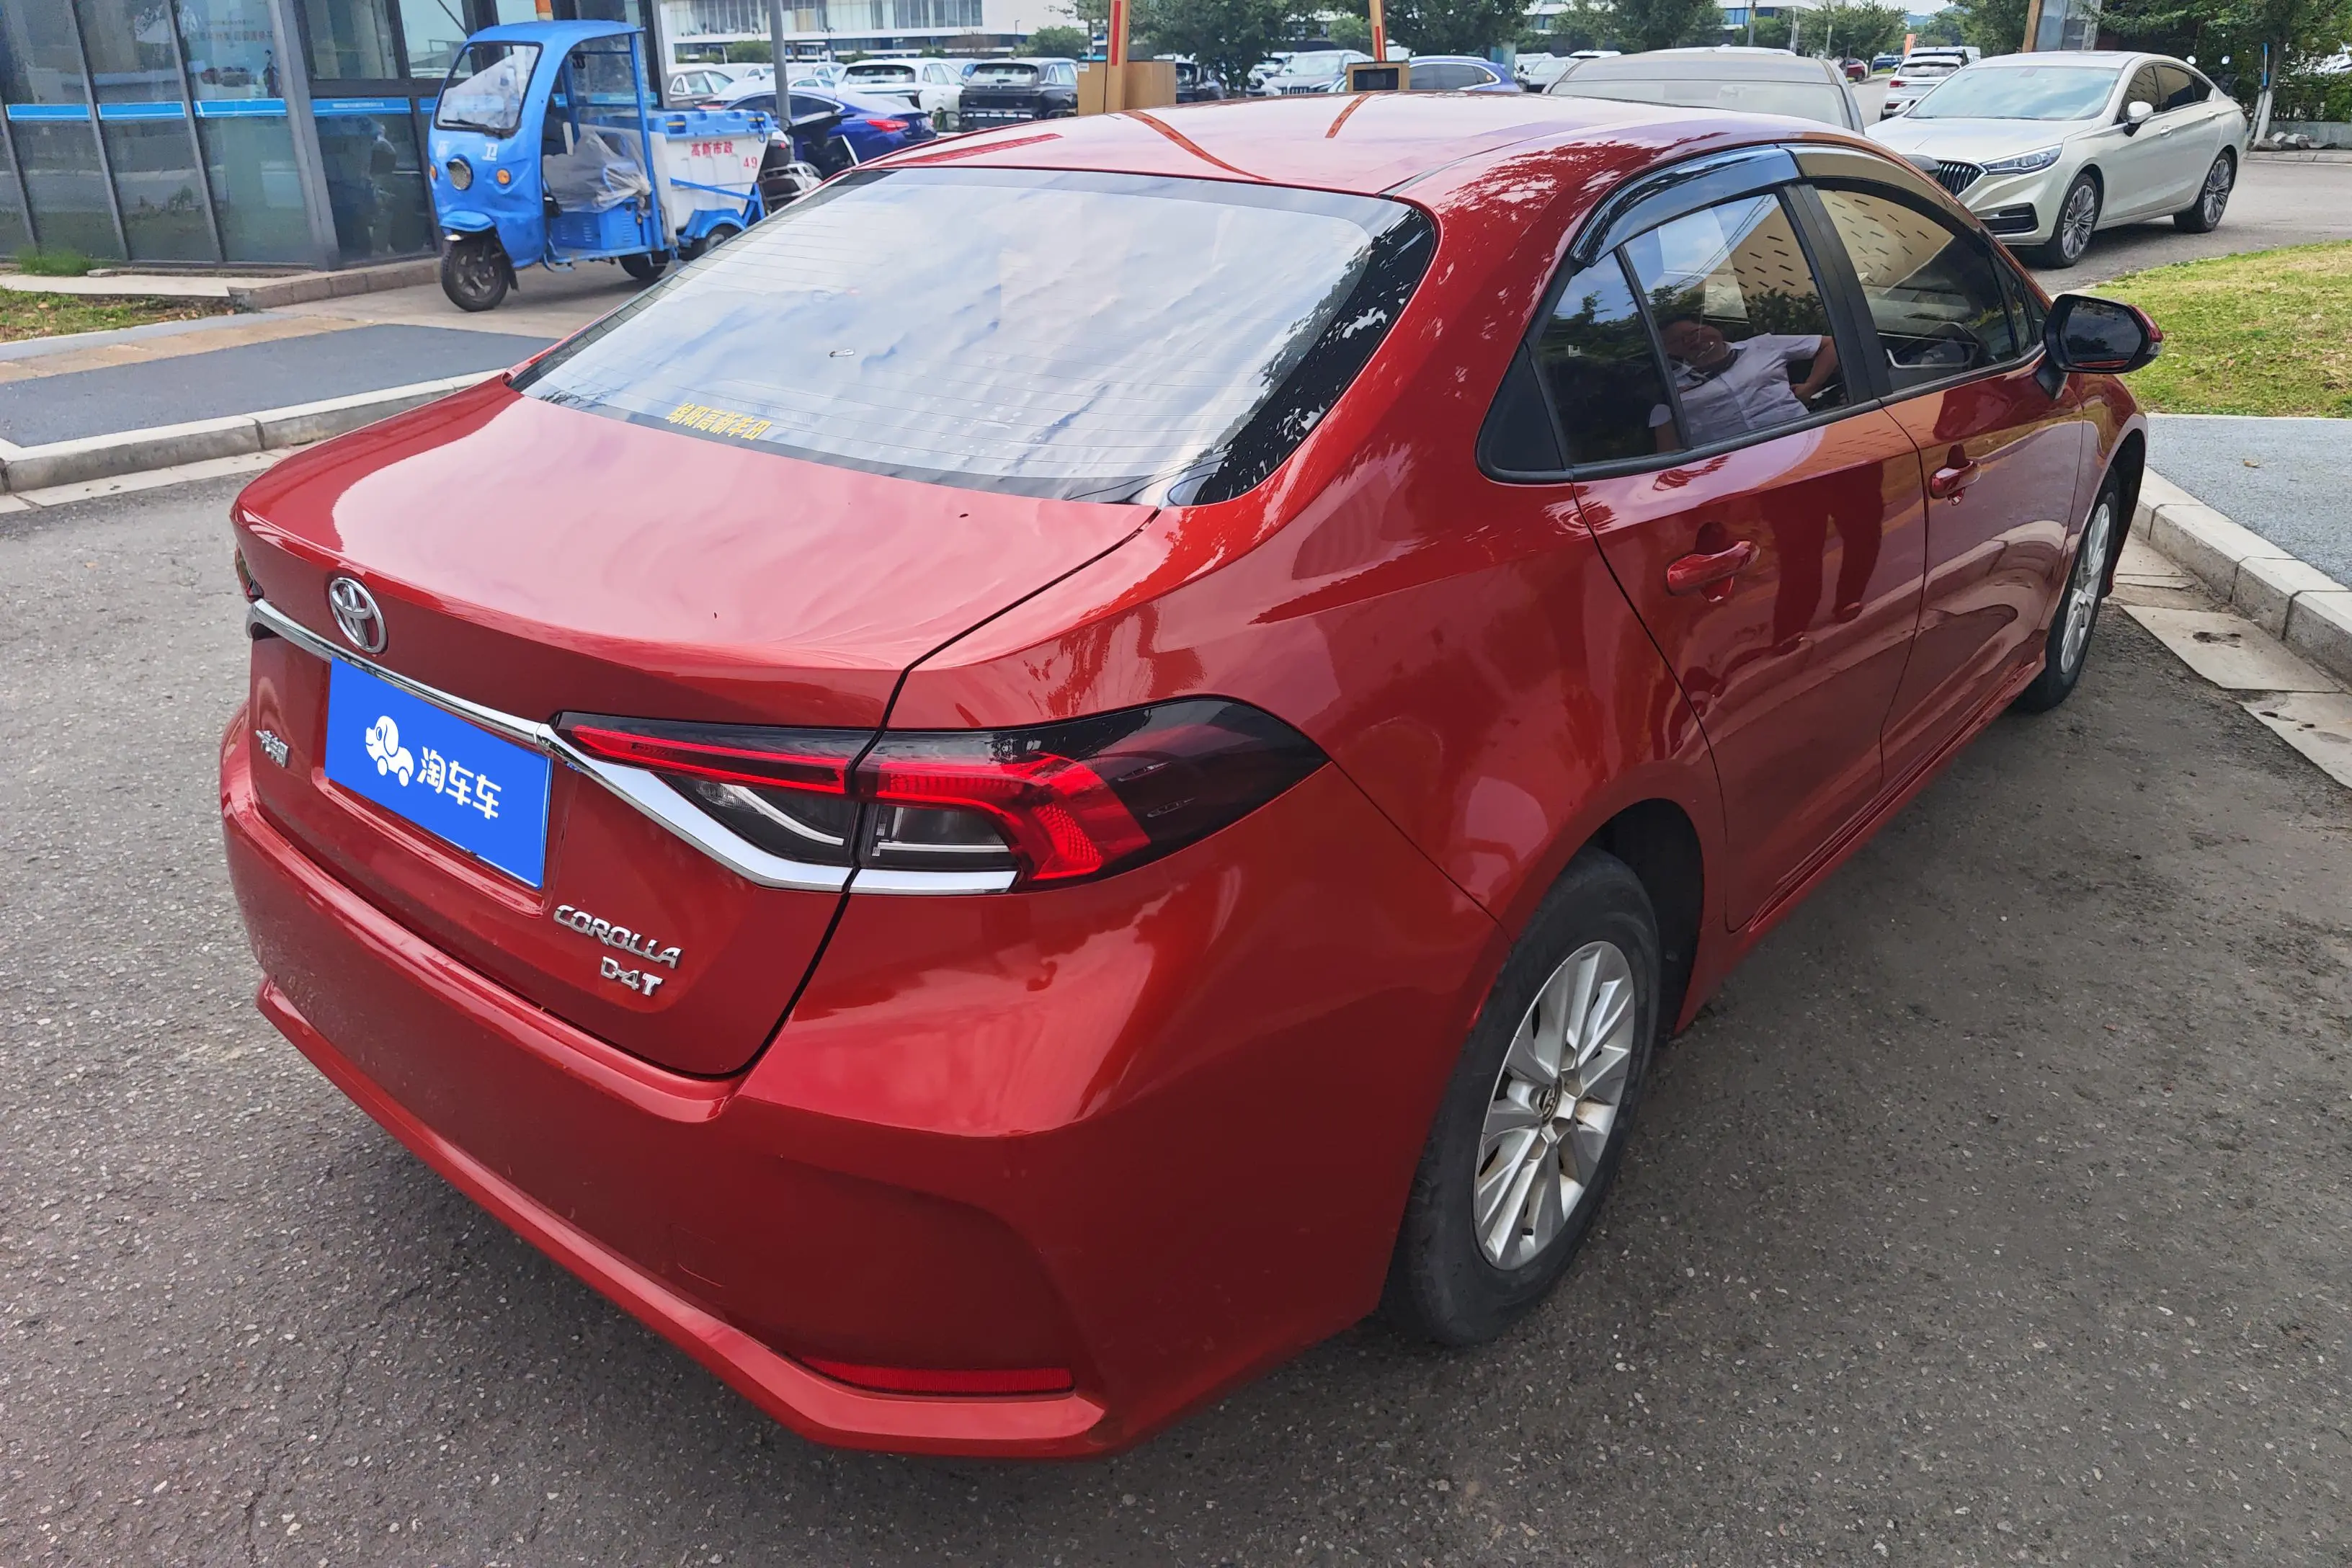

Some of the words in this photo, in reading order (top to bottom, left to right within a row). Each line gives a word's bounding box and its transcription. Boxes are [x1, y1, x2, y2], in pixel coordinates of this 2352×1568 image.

[743, 156, 759, 169] 49
[553, 904, 684, 969] COROLLA
[600, 956, 664, 997] D-4T
